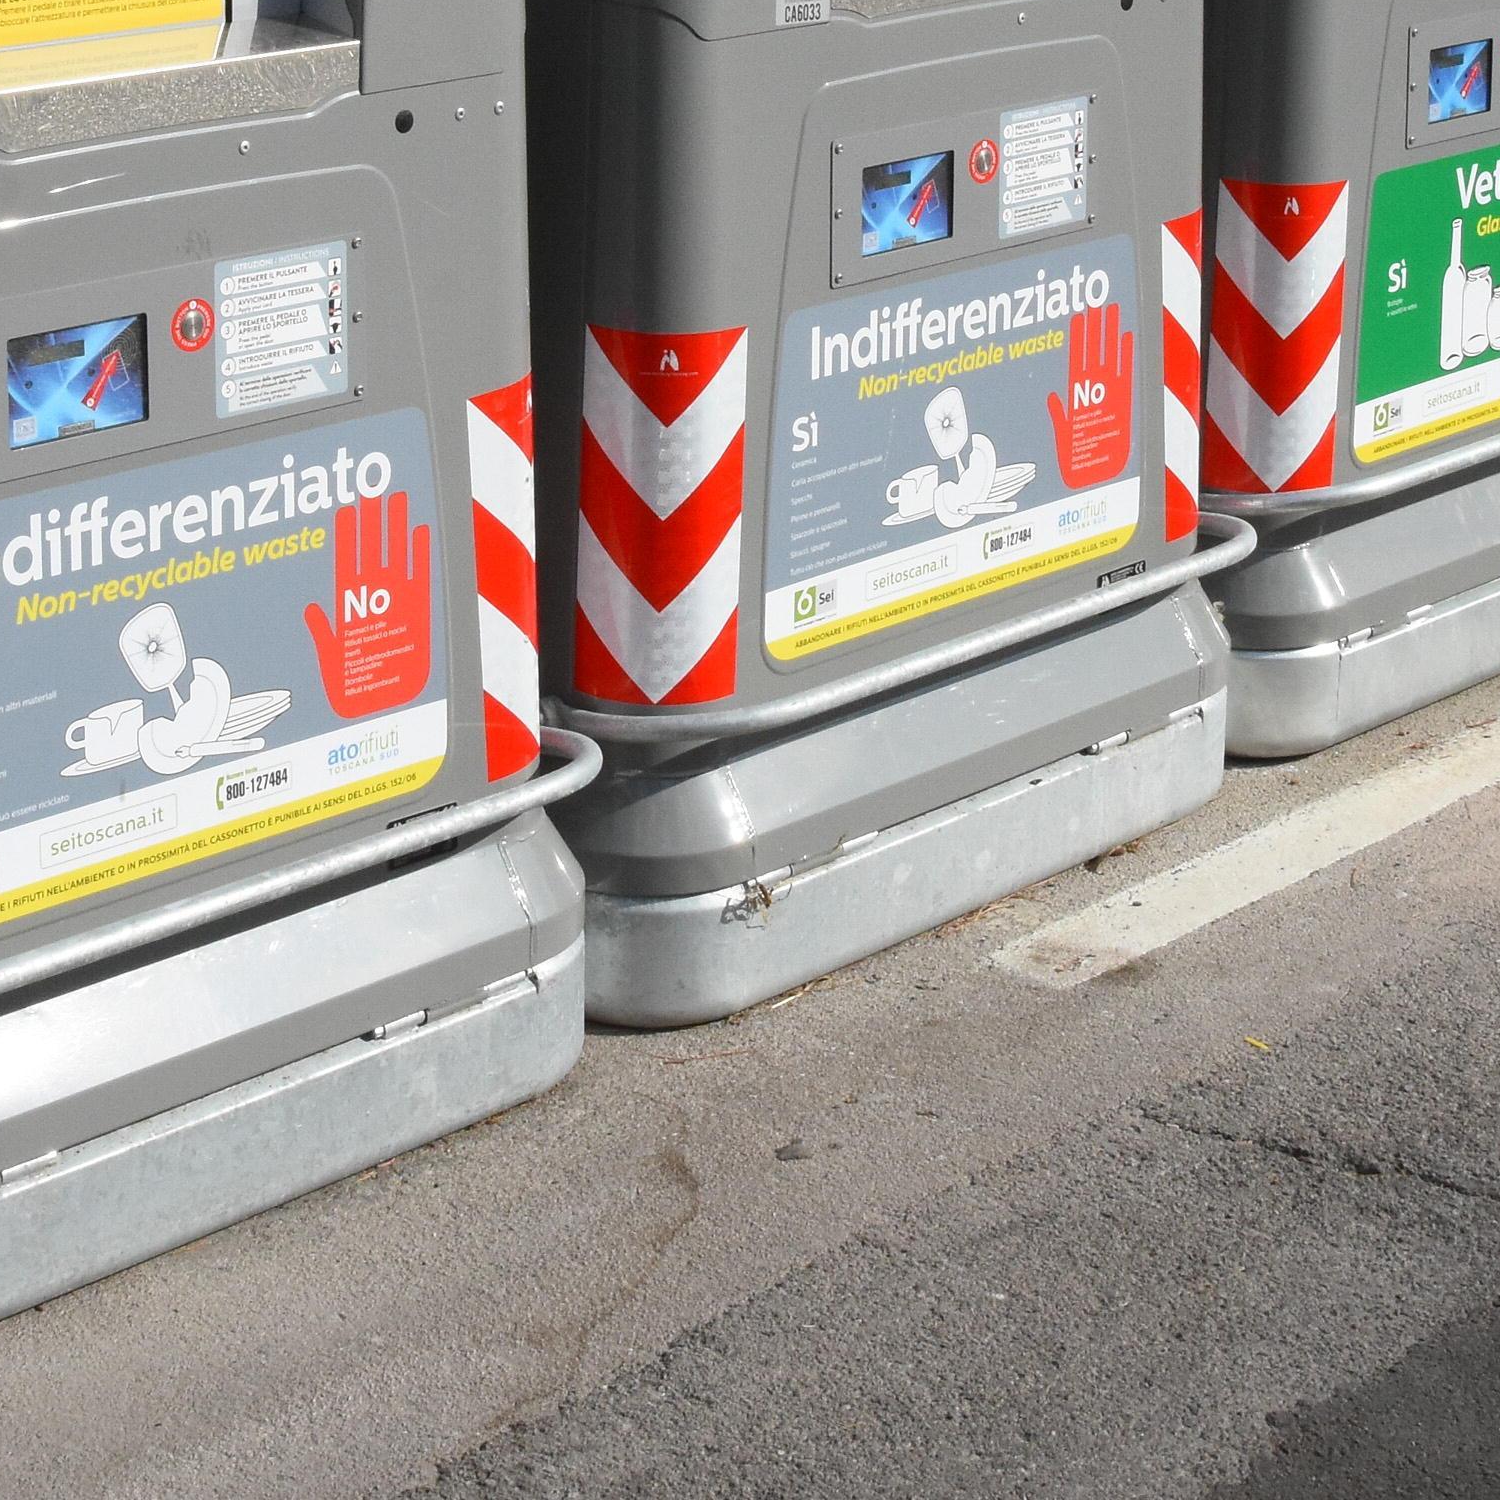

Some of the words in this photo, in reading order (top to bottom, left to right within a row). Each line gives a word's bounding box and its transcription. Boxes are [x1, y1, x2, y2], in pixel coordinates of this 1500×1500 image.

[785, 3, 821, 23] CA6033
[237, 273, 267, 284] PREMERE
[276, 266, 307, 277] PULSANTE
[1387, 258, 1407, 292] Sì
[238, 293, 276, 305] AVVICINARE
[287, 286, 313, 296] TESSERA
[808, 260, 1108, 380] Indifferenziato
[858, 344, 1003, 398] Non-recyclable
[1009, 328, 1063, 358] waste
[1073, 380, 1105, 408] No
[1427, 381, 1479, 408] seitoscana.it
[790, 411, 819, 451] Sì
[16, 550, 235, 623] Non-recyclable
[244, 527, 325, 564] waste
[873, 554, 948, 590] seitoscana.it
[344, 587, 389, 620] No
[818, 589, 834, 604] Sei
[22, 690, 56, 706] materiali
[328, 726, 398, 764] atorifiuti
[329, 756, 374, 775] TOSCANA
[380, 749, 398, 759] SUD
[226, 768, 287, 800] 800-127484
[11, 805, 36, 817] essere
[39, 795, 68, 809] riciclato
[12, 890, 43, 907] RIFIUTI
[47, 868, 115, 896] NELL'AMBIENTE
[118, 865, 123, 873] O
[127, 862, 135, 871] IN
[138, 843, 189, 867] PROSSIMITÀ
[192, 839, 206, 850] DEL
[210, 821, 265, 844] CASSONETTO
[274, 807, 311, 823] PUNIBILE
[313, 803, 320, 811] AI
[323, 796, 345, 808] SENSI
[348, 790, 362, 800] DEL
[364, 783, 387, 795] D.LGS.
[390, 773, 416, 787] 152/06
[51, 807, 163, 854] seitoscana.it
